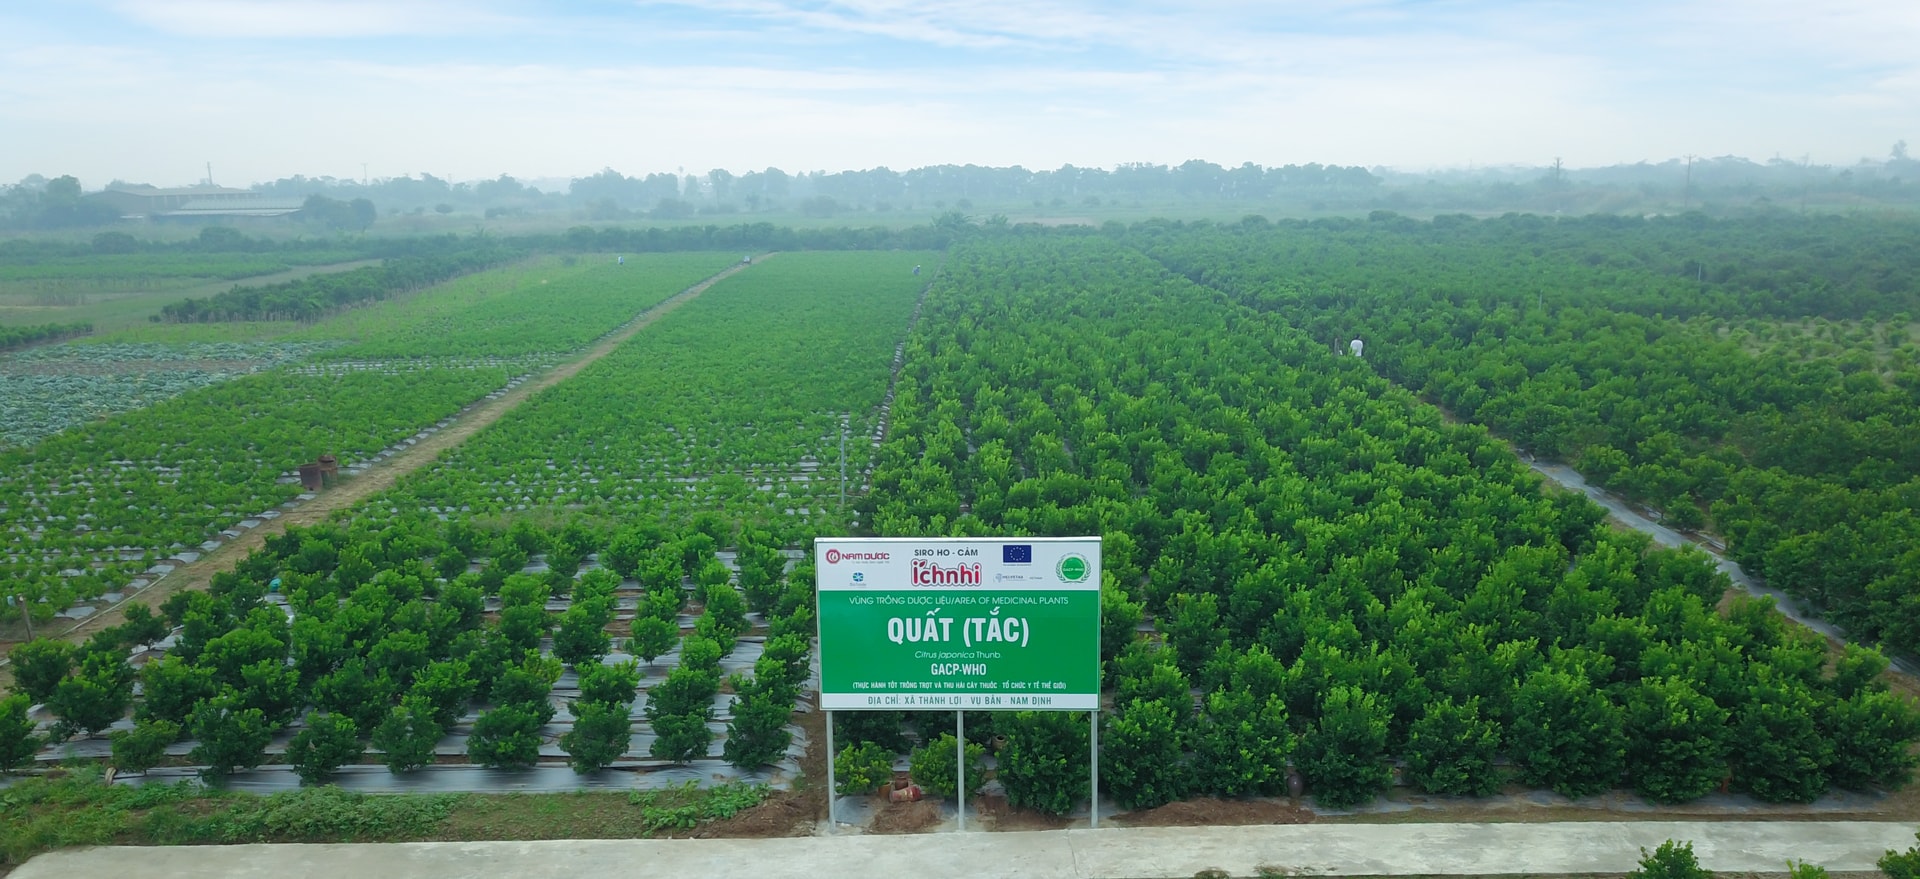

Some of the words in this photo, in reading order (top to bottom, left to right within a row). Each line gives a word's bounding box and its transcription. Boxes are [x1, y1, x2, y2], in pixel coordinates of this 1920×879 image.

[957, 547, 978, 556] CẢM
[849, 596, 874, 605] VÙNG
[876, 594, 905, 605] TRỒNG
[907, 597, 933, 605] DƯỢC
[888, 608, 953, 644] QUẤT
[963, 606, 1029, 647] (TẮC)
[938, 651, 975, 660] japonica
[931, 663, 986, 675] GACP-WHO
[1032, 697, 1052, 706] ĐỊNH
